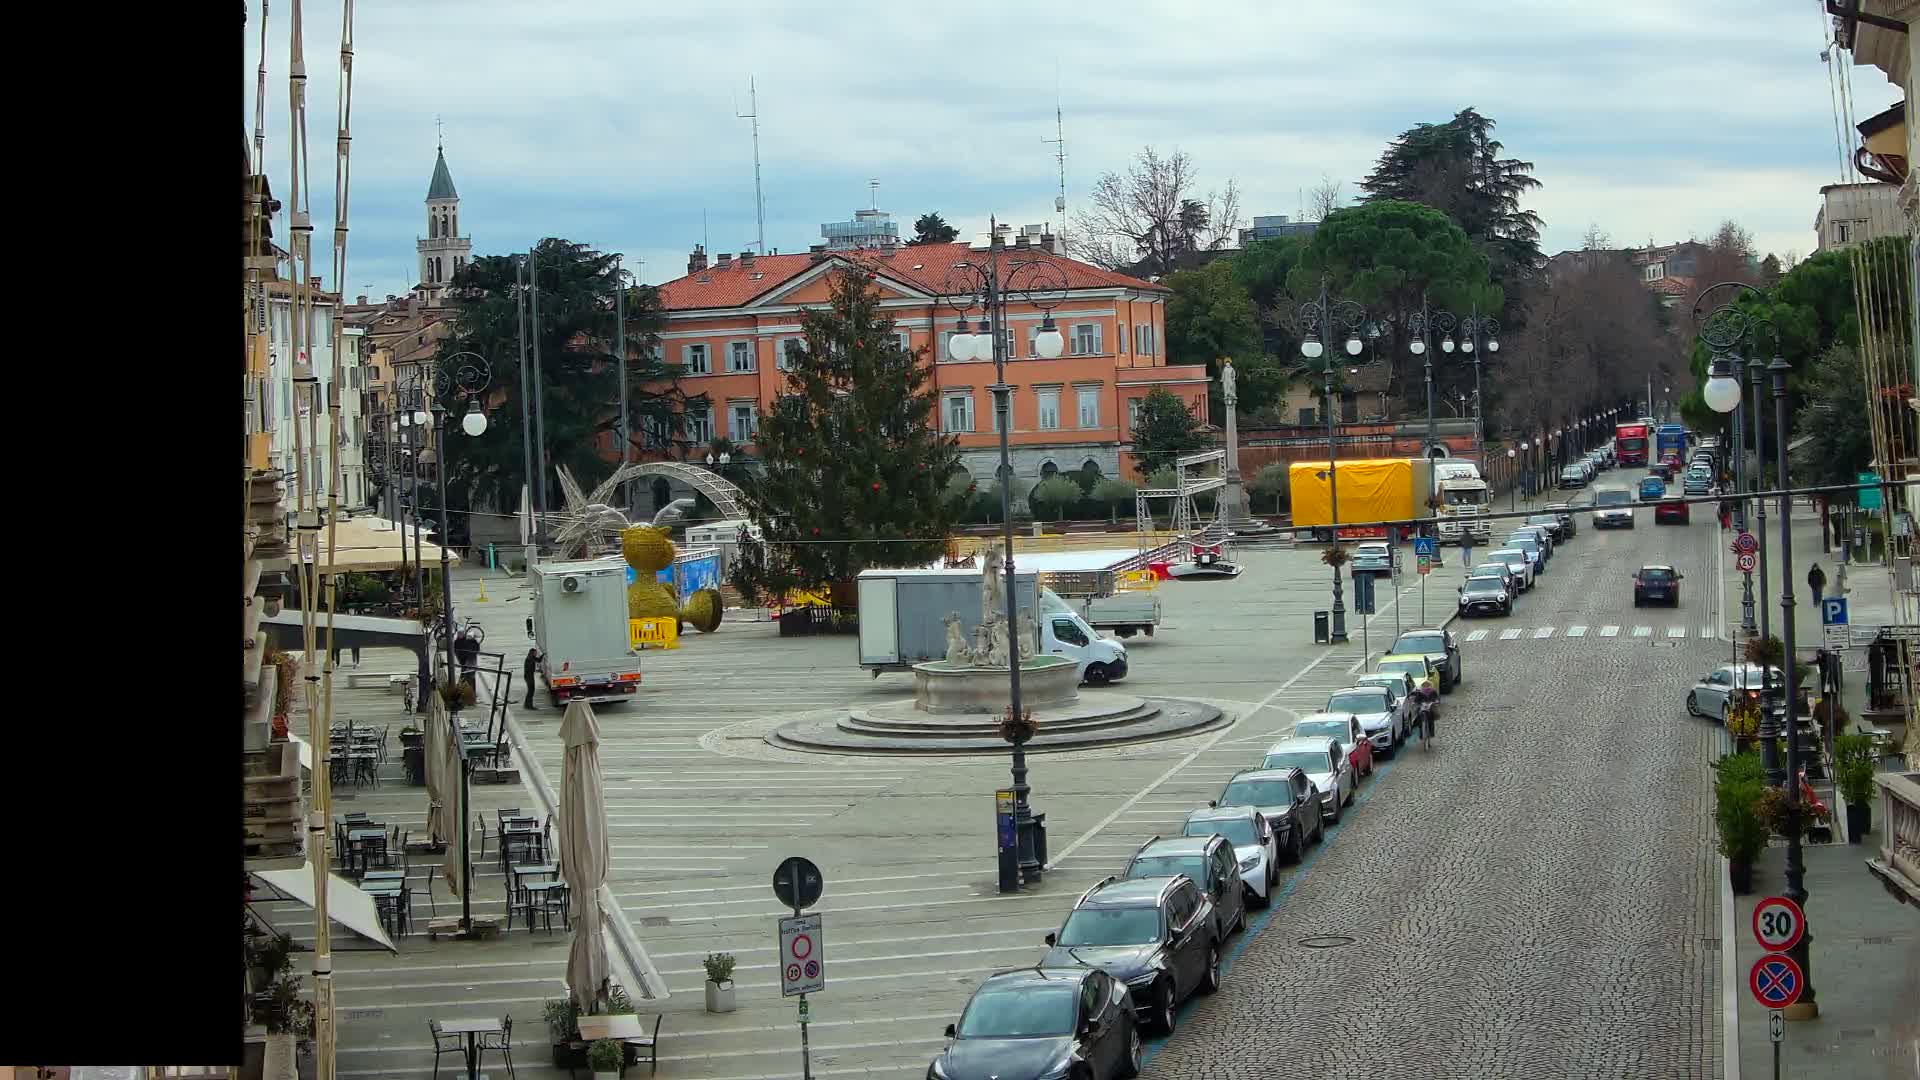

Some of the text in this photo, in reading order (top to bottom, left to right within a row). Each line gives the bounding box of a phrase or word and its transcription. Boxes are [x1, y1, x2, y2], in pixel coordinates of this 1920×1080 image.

[1742, 557, 1752, 566] 20
[1827, 602, 1841, 621] P
[1762, 911, 1791, 937] 30
